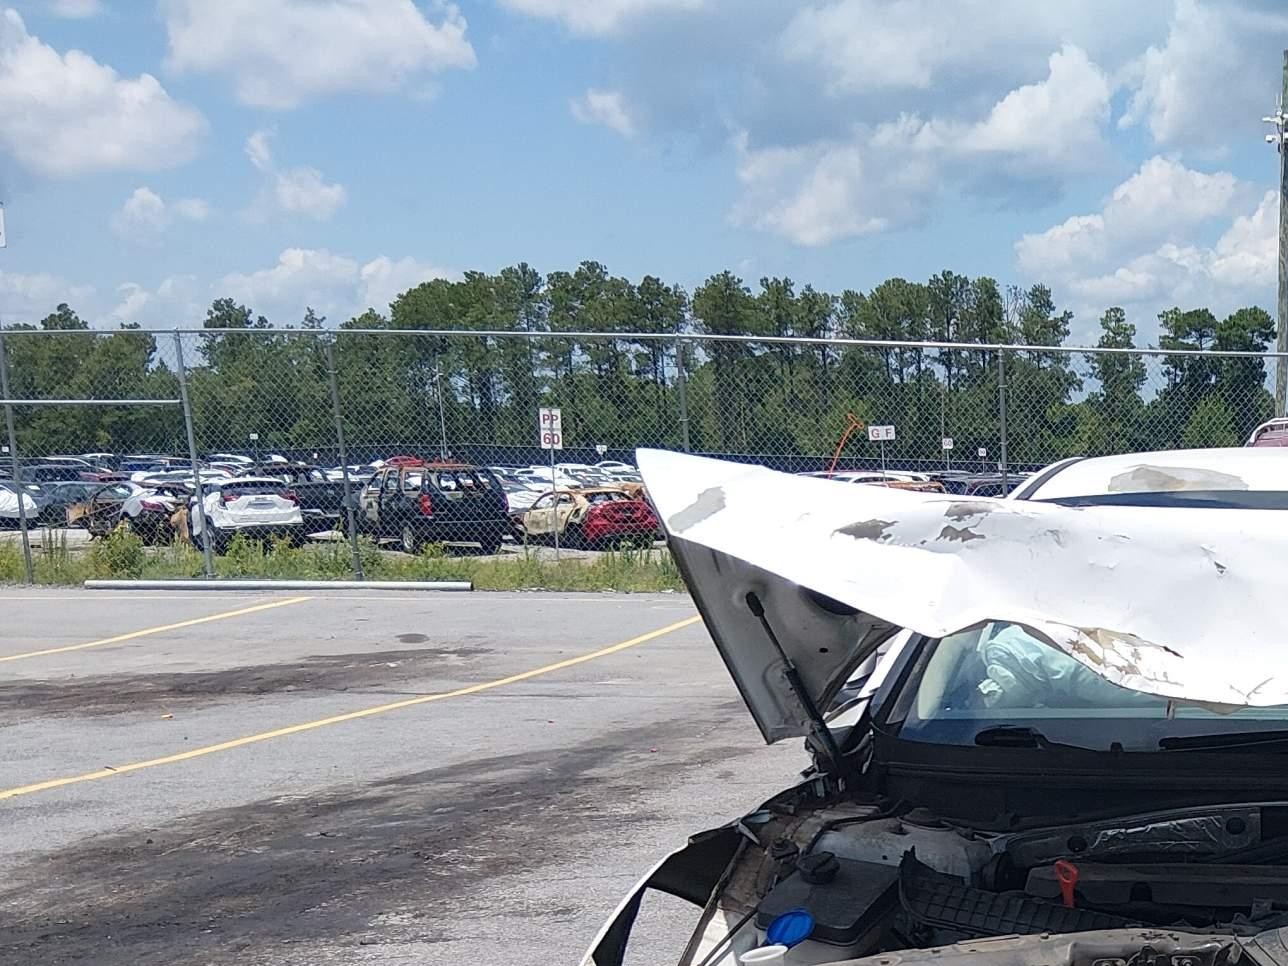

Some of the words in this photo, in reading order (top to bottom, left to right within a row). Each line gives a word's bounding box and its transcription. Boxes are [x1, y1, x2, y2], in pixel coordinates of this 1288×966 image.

[542, 414, 559, 424] PP
[543, 432, 560, 445] 60
[871, 429, 880, 439] G
[885, 428, 892, 438] F
